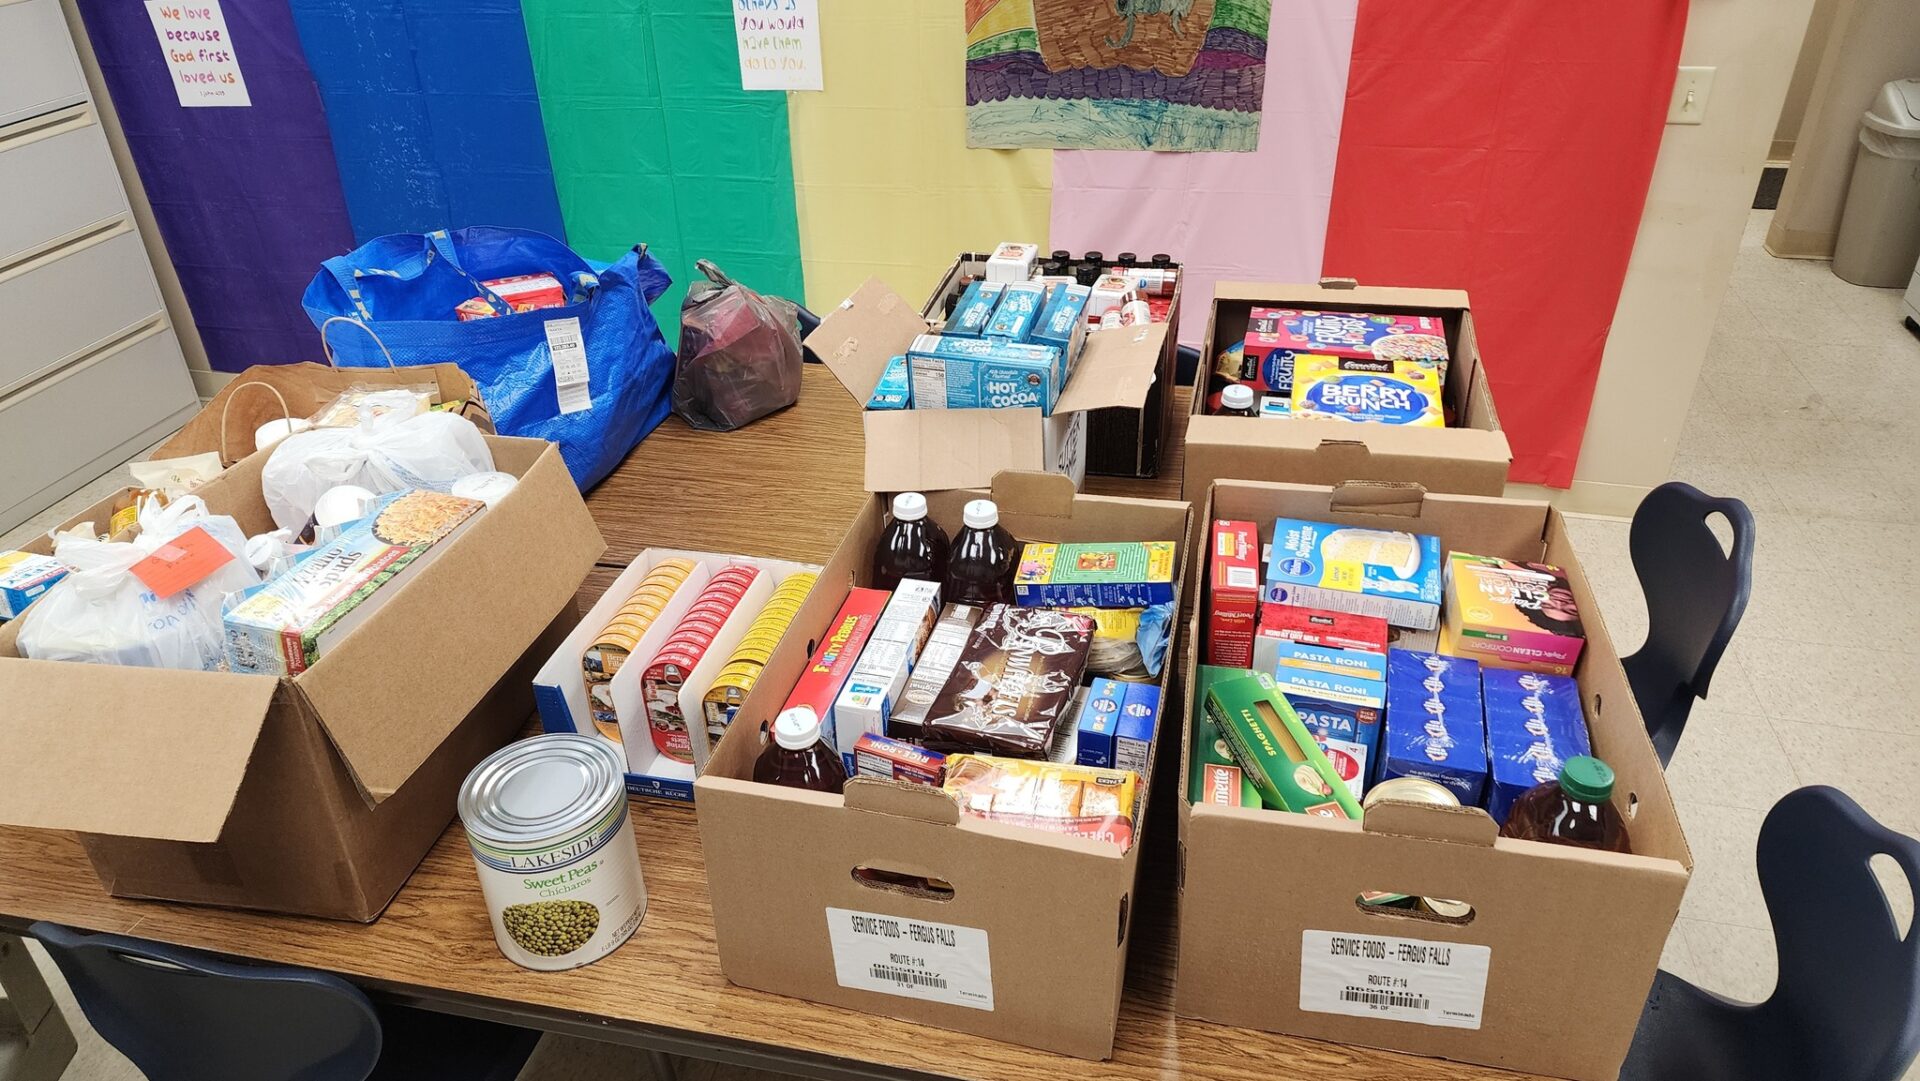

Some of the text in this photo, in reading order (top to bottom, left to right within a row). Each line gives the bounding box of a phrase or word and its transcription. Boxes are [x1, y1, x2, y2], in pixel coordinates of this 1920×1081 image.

[160, 5, 211, 20] We love
[165, 29, 220, 42] because
[170, 49, 230, 63] God first
[179, 70, 236, 84] loved us
[989, 382, 1016, 394] HOT
[1322, 384, 1411, 400] BERRY
[992, 394, 1038, 408] COCOA
[1321, 395, 1411, 411] CRUNCH
[1285, 530, 1300, 550] Moist
[1296, 526, 1313, 558] Supreme
[1479, 583, 1550, 600] CLEAN
[1488, 595, 1542, 610] Playtex
[813, 643, 843, 672] FRUITY
[830, 614, 858, 643] PEBBLES
[1472, 642, 1512, 653] COMFORT
[1512, 647, 1543, 657] CLEAN
[1294, 651, 1332, 663] PASTA
[1336, 657, 1368, 668] RONI
[1292, 677, 1368, 696] PASTA RONI
[1297, 711, 1352, 732] PASTA
[1241, 709, 1277, 757] SPAGHETTI
[857, 752, 892, 766] Nutrition Facts
[870, 741, 897, 753] RONI
[903, 751, 930, 763] RICE
[510, 832, 599, 868] LAKESIDE
[523, 861, 598, 890] Sweet Peas
[851, 915, 879, 935] SERVICE
[879, 919, 901, 939] FOODS
[909, 923, 936, 945] FERGUS
[936, 928, 956, 947] FALLS
[890, 953, 910, 966] ROUTE
[1330, 937, 1360, 957] SERVICE
[1362, 940, 1386, 960] FOODS
[1397, 943, 1427, 963] FERGUS
[1428, 946, 1451, 966] FALLS
[1368, 974, 1390, 988] ROUTE
